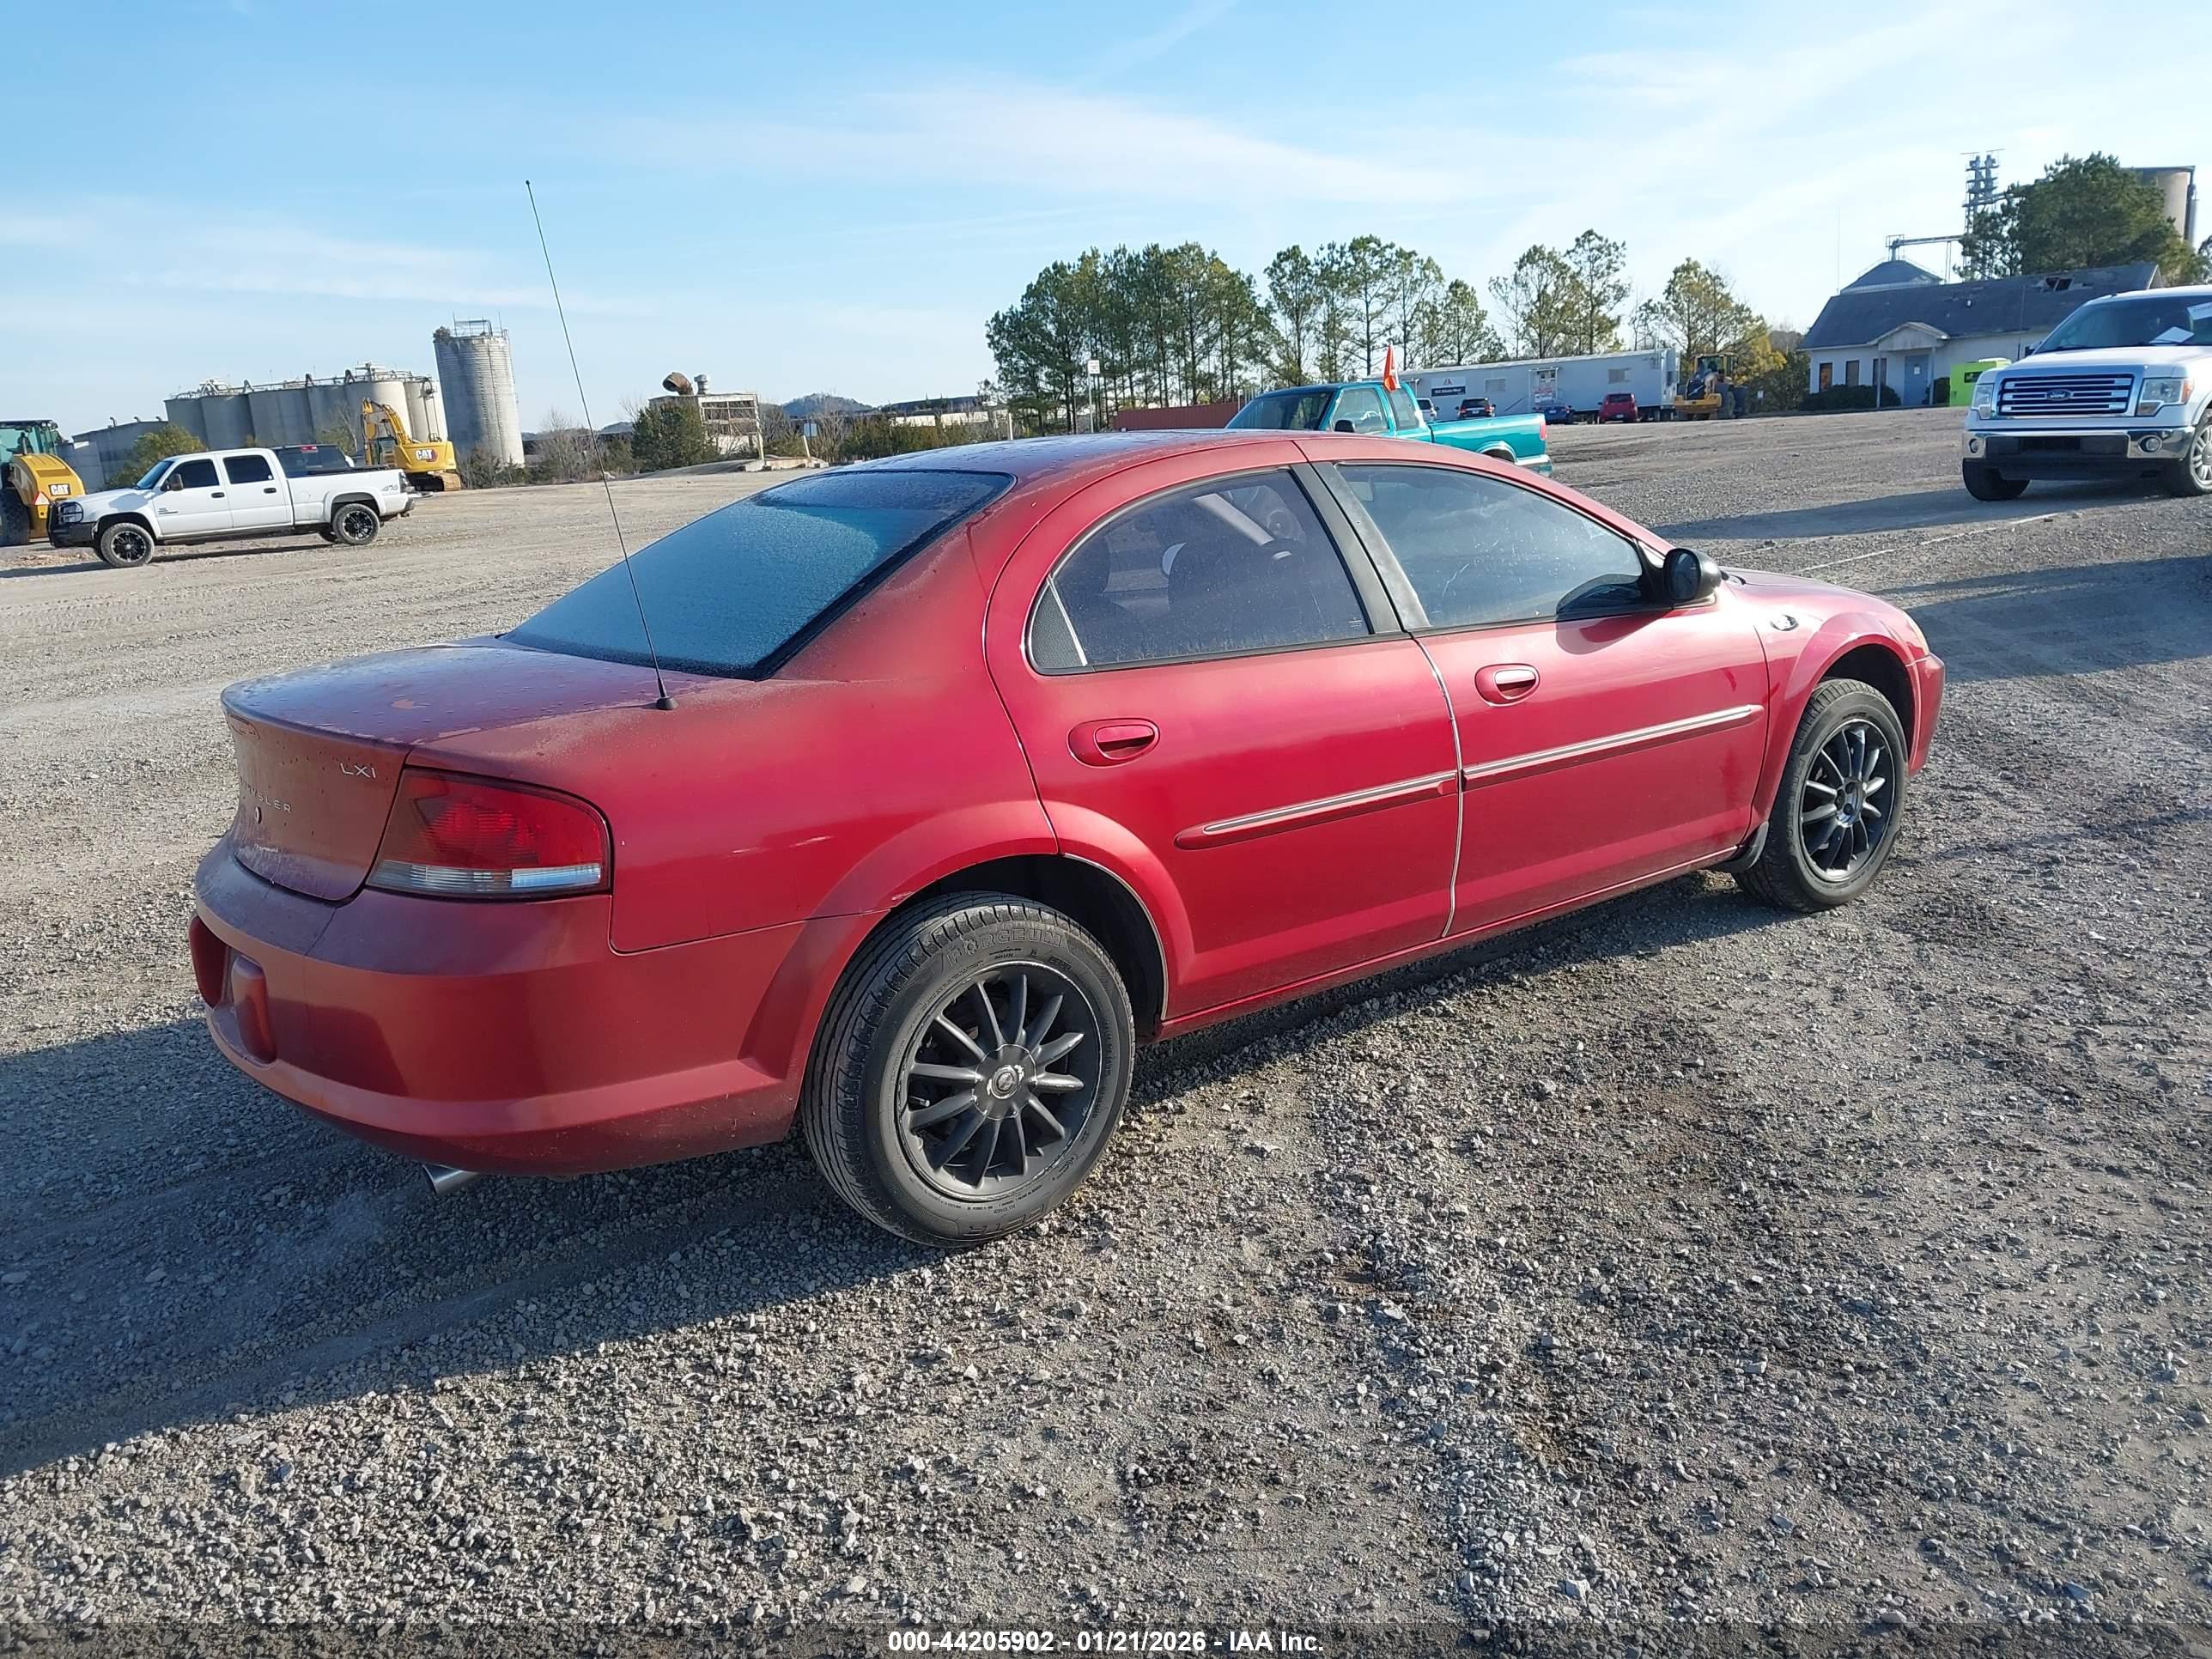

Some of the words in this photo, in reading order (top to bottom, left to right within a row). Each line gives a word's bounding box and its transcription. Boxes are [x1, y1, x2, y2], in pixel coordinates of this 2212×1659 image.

[416, 448, 433, 460] CAT
[50, 483, 69, 495] CAT
[946, 928, 1062, 967] FORCEUM
